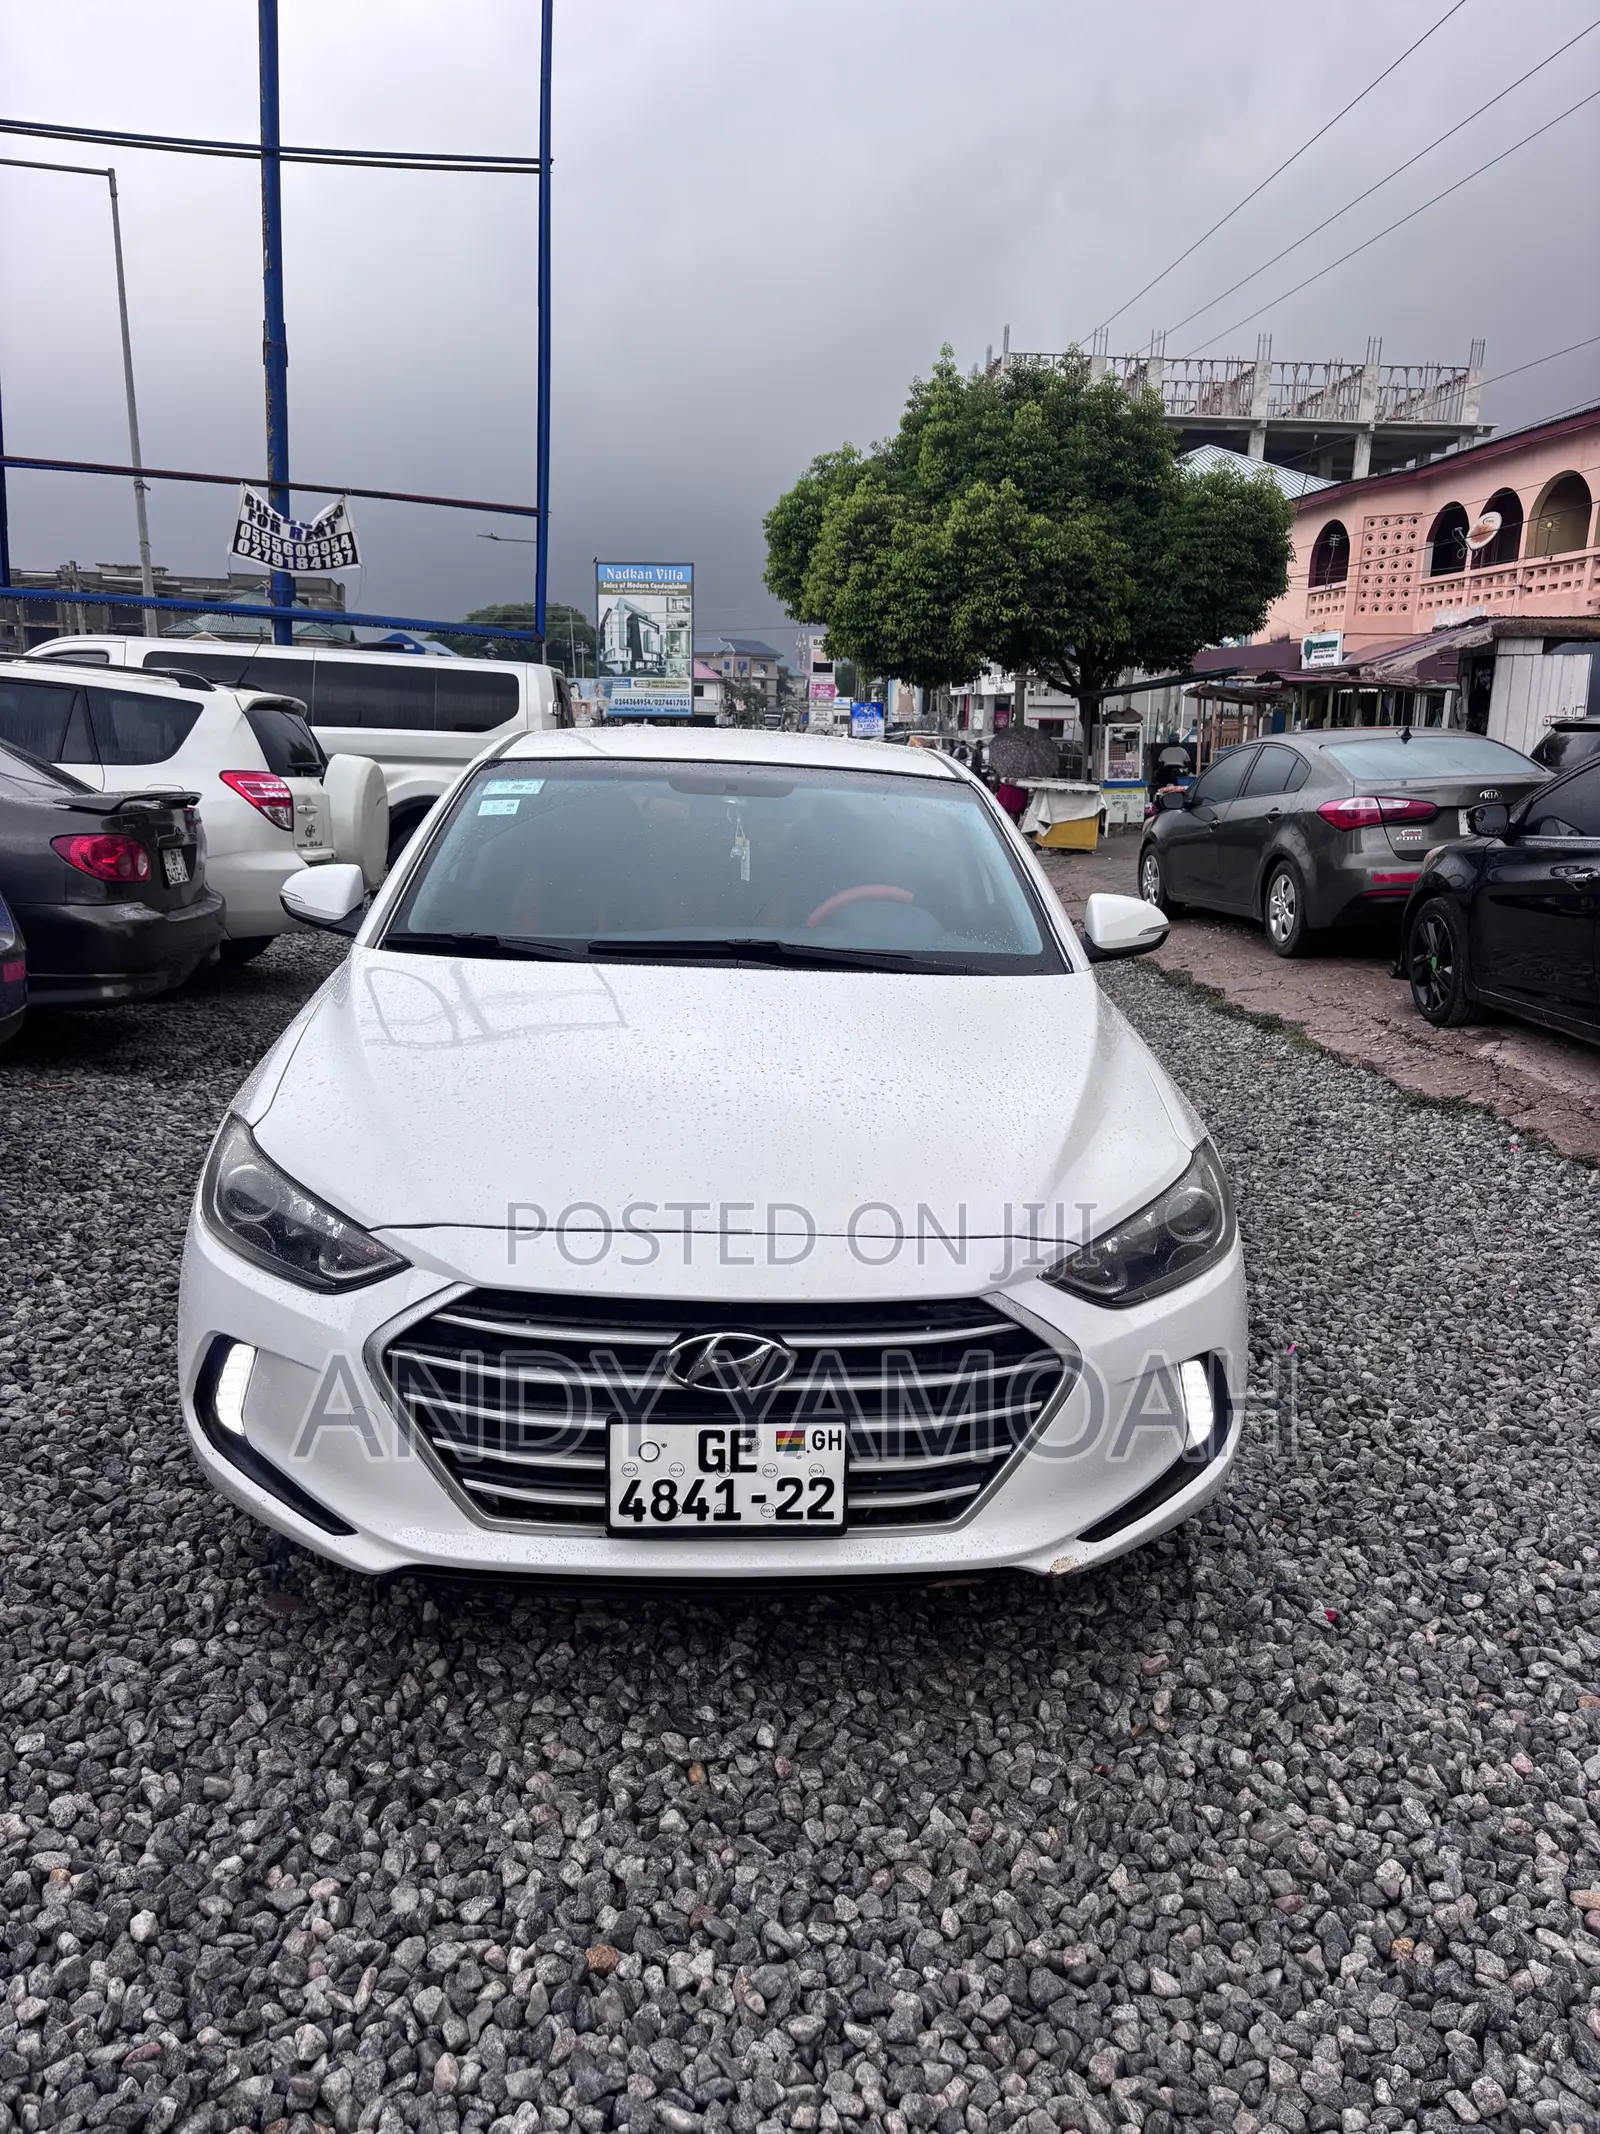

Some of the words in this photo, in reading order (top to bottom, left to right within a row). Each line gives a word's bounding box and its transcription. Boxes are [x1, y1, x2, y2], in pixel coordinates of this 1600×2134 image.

[248, 508, 281, 536] FOR
[239, 523, 352, 558] 0555606954
[237, 539, 354, 571] 0279184137
[602, 581, 618, 589] Sales
[619, 581, 626, 589] of
[606, 567, 652, 580] Nadkan
[656, 568, 683, 580] Villa
[1484, 792, 1500, 800] KIA
[698, 1428, 758, 1473] GE
[811, 1429, 843, 1451] GH
[618, 1477, 835, 1522] 4841-22
